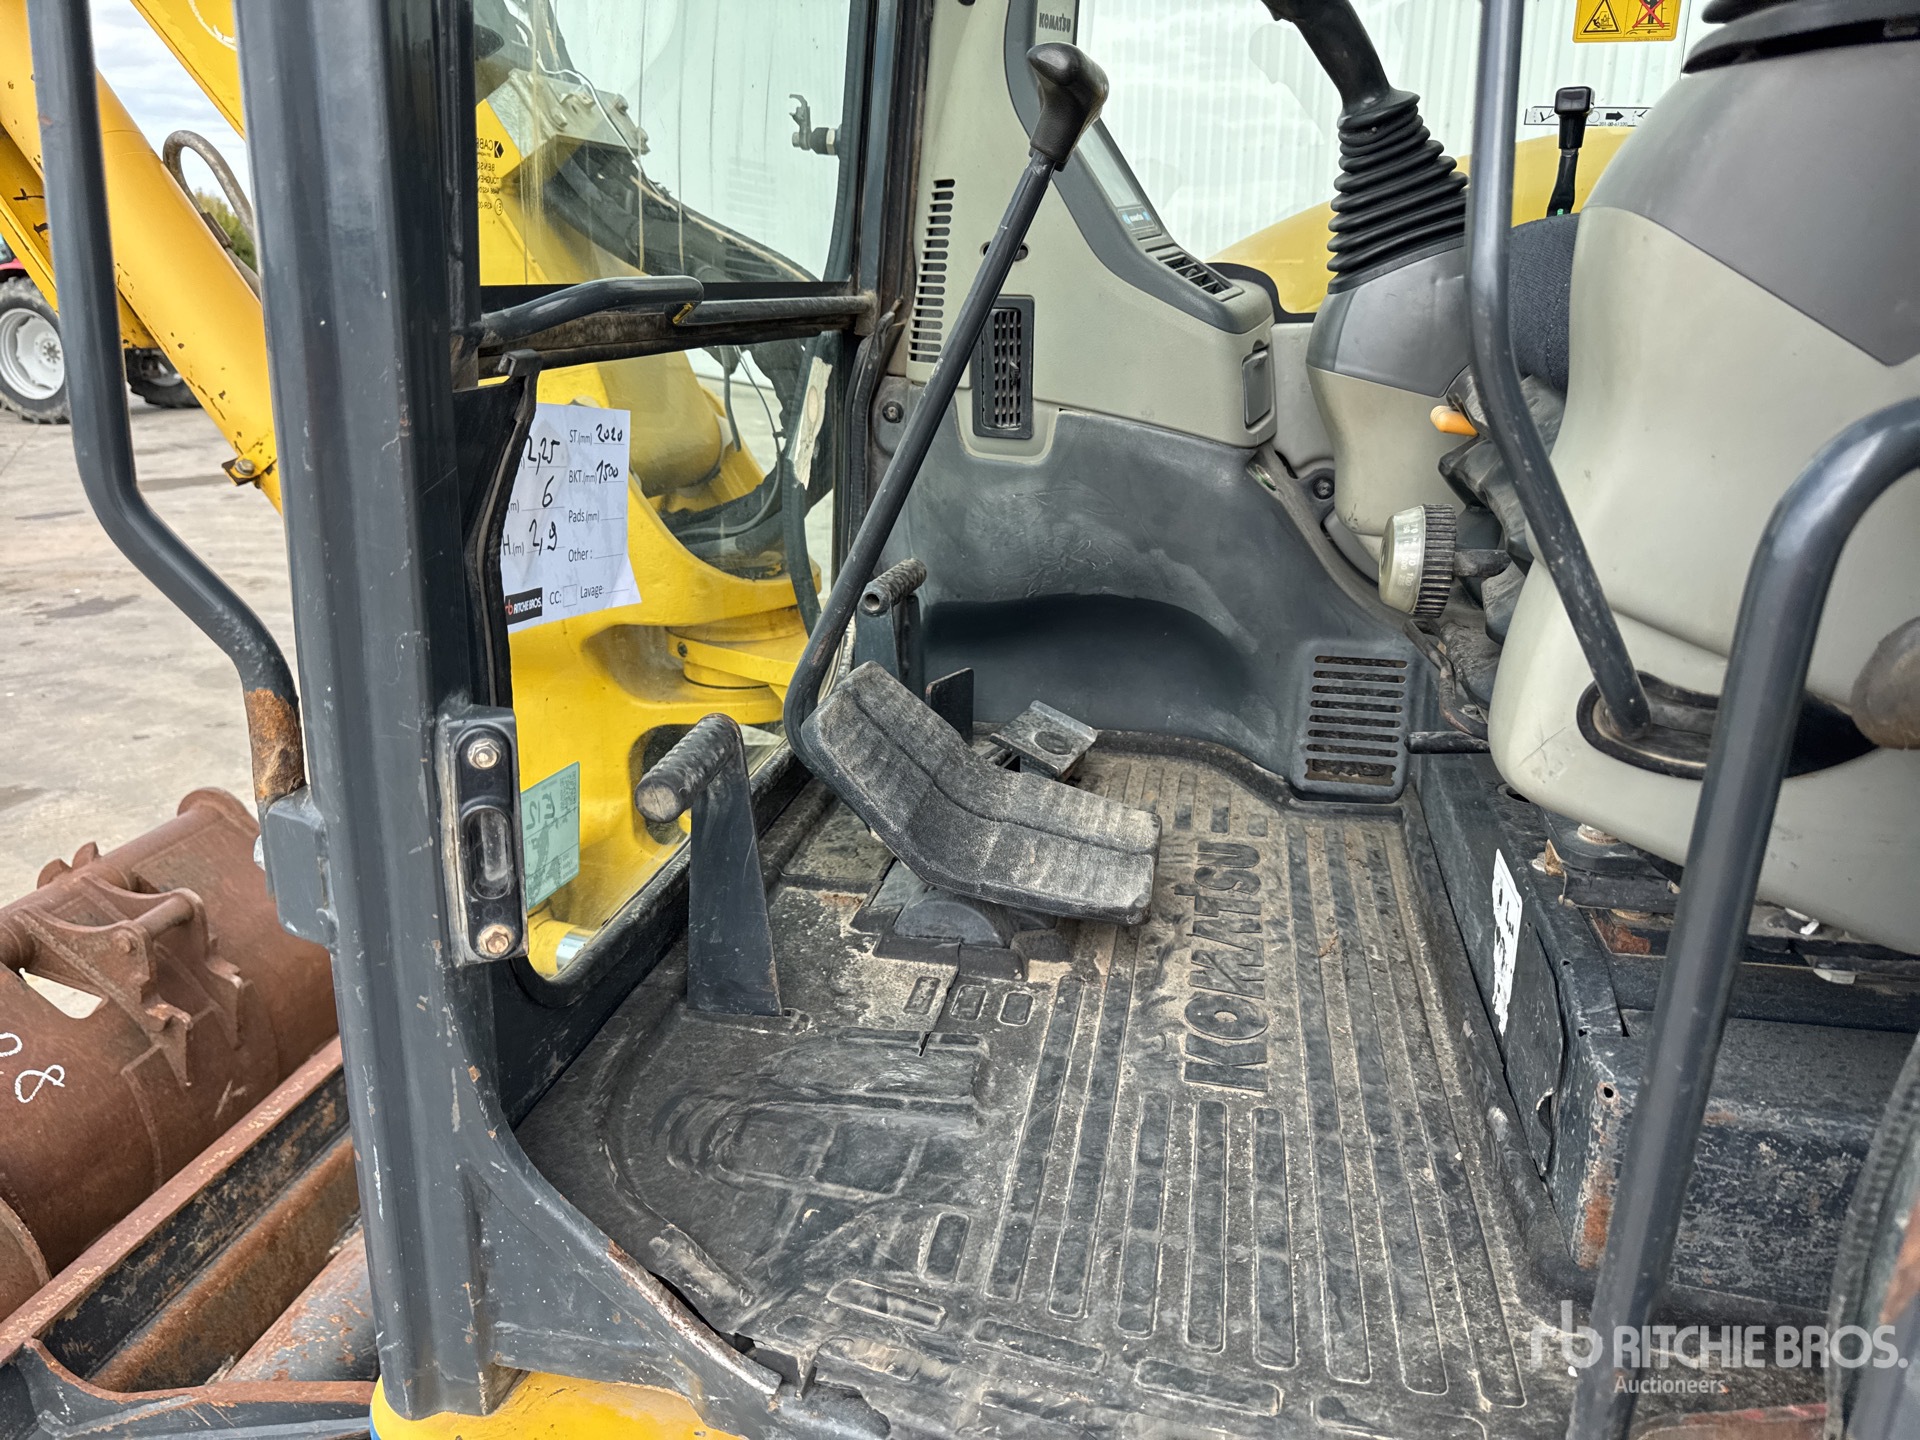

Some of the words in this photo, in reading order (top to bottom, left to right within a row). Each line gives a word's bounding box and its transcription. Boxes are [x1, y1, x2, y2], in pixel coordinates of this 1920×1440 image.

[1039, 12, 1072, 33] KOMATSU
[595, 423, 623, 443] 2020
[596, 459, 619, 484] 1500
[541, 475, 555, 508] 6
[568, 548, 588, 562] Other
[1175, 842, 1269, 1093] KOMATSU
